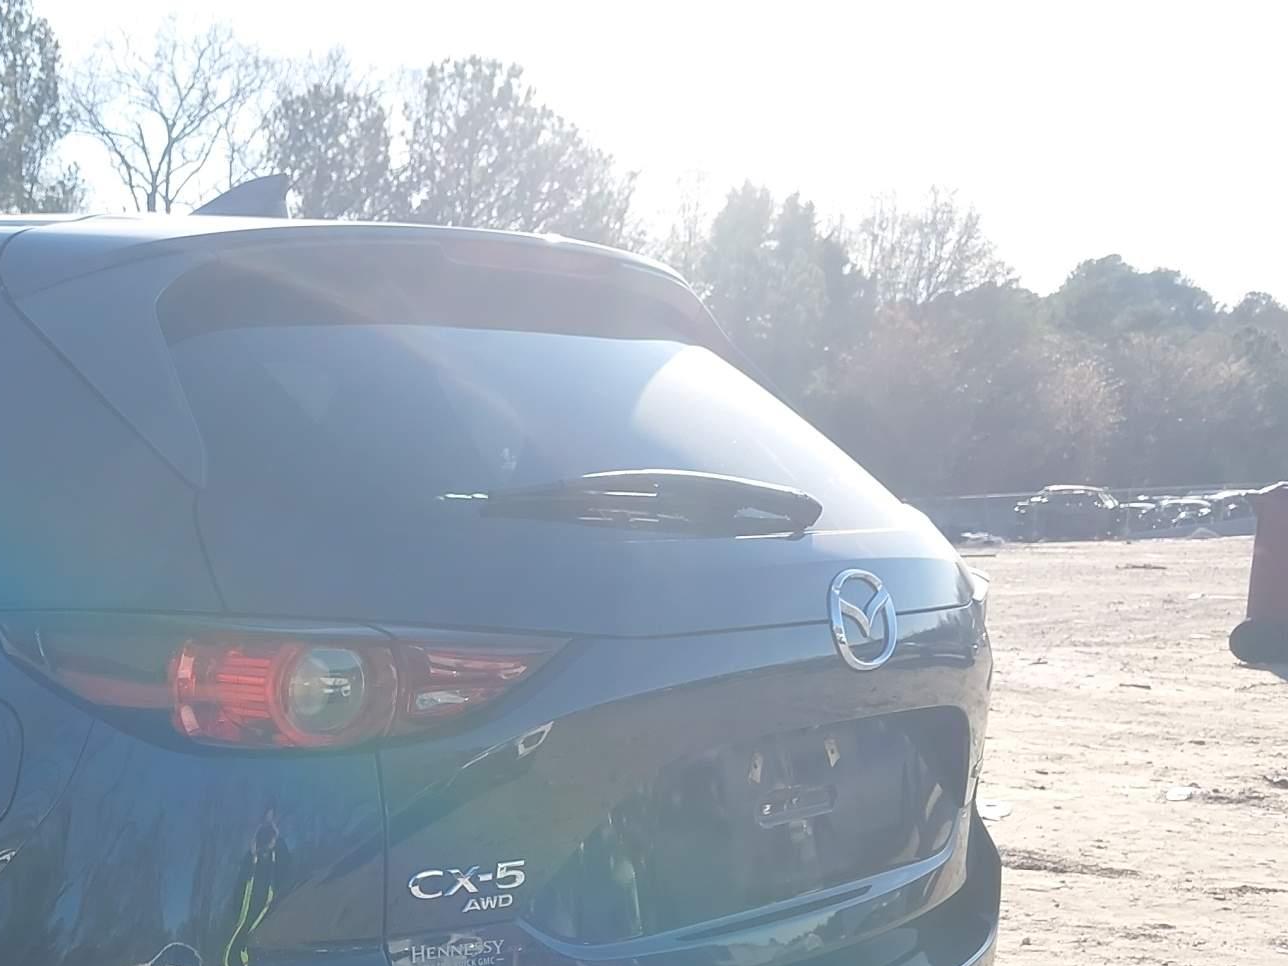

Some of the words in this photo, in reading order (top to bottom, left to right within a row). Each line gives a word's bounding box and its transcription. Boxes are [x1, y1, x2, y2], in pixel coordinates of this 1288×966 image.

[408, 860, 525, 900] CX-5
[462, 893, 513, 913] AWD
[411, 939, 505, 964] HENNESSY
[477, 957, 495, 966] GMC
